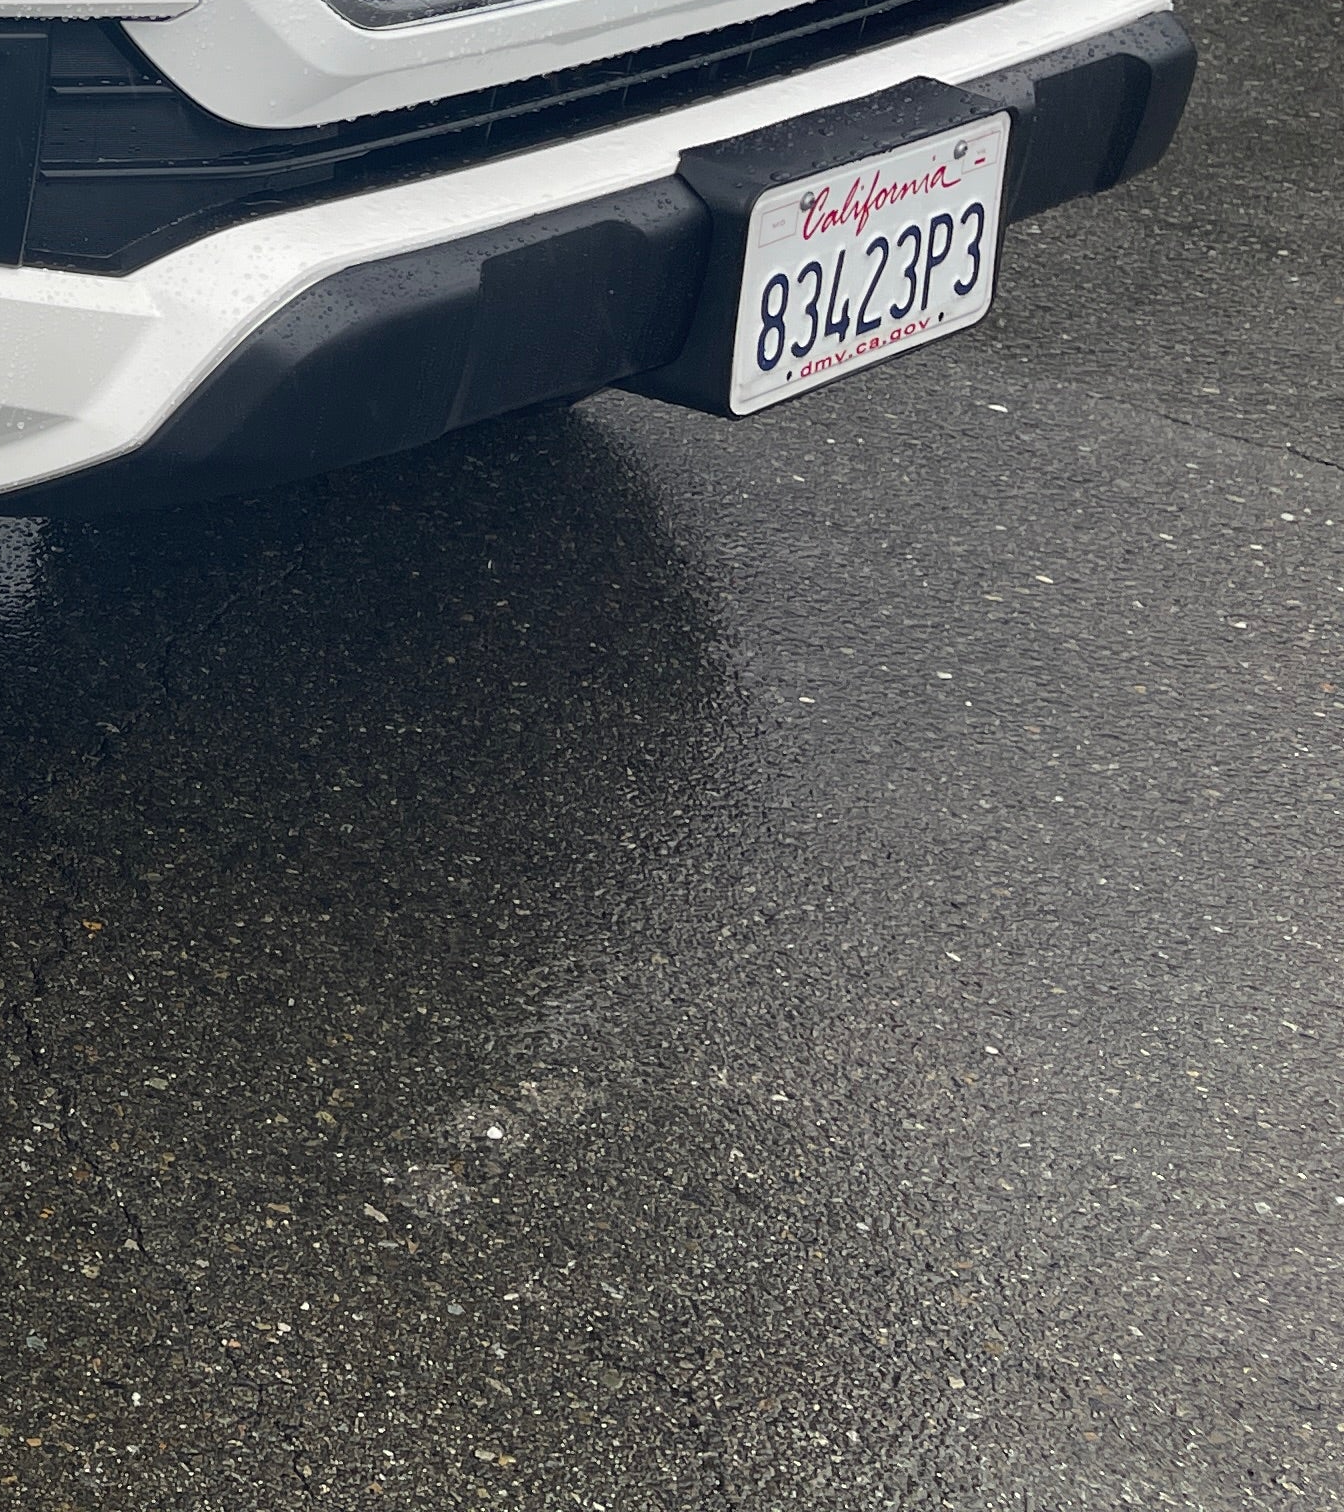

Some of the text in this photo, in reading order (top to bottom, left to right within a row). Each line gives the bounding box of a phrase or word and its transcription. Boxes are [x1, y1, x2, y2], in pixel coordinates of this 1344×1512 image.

[802, 155, 961, 240] California
[756, 201, 985, 372] 83423P3
[799, 317, 931, 377] dmv.ca.gov
